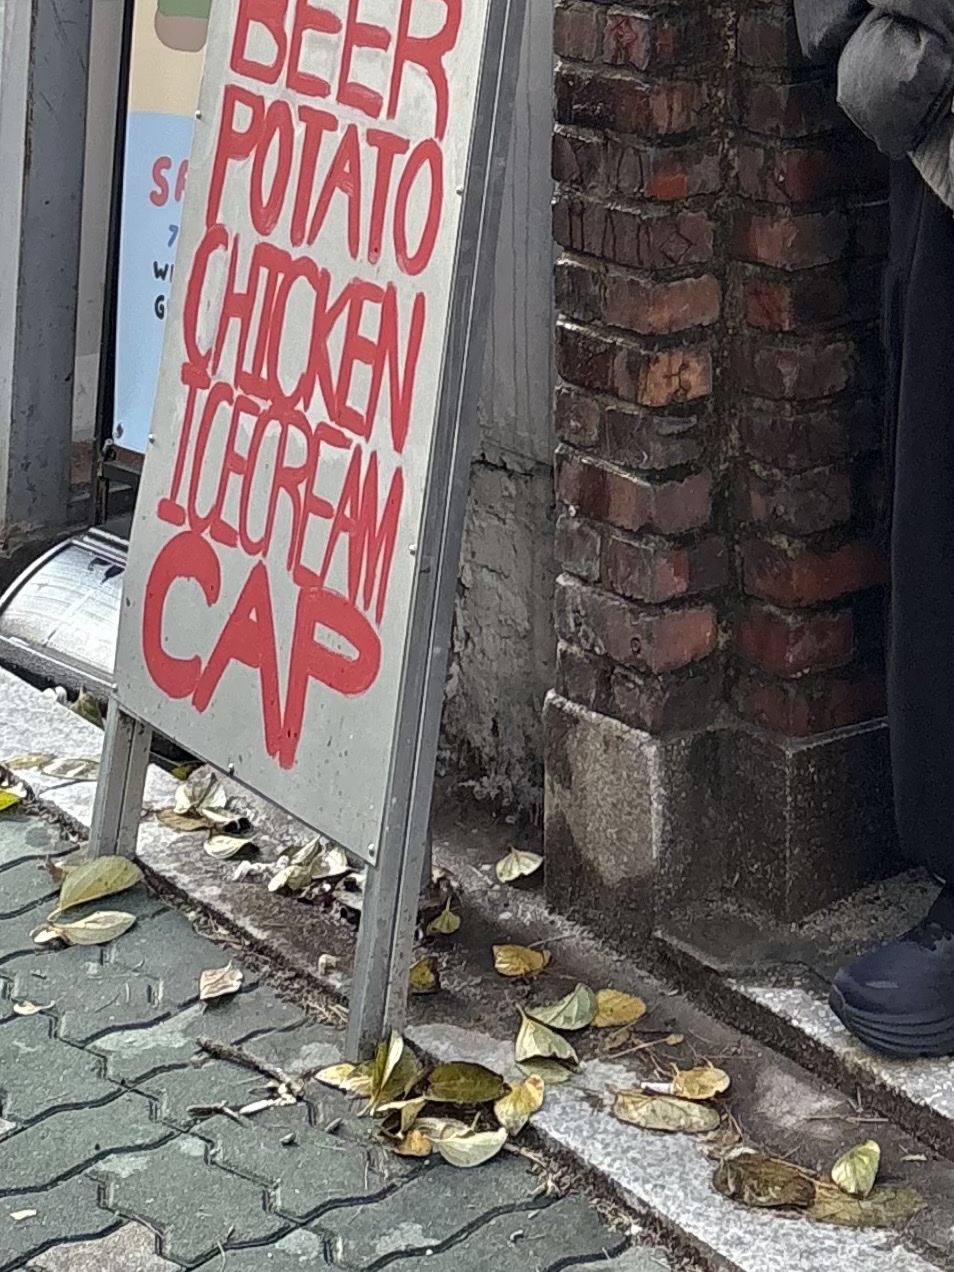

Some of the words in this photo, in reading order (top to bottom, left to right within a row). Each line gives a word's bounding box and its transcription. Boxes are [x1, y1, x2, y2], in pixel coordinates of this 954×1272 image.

[205, 84, 443, 276] POTATO
[183, 222, 426, 454] CHICKEN
[157, 362, 405, 627] ICECREAM
[143, 530, 382, 770] CAP
